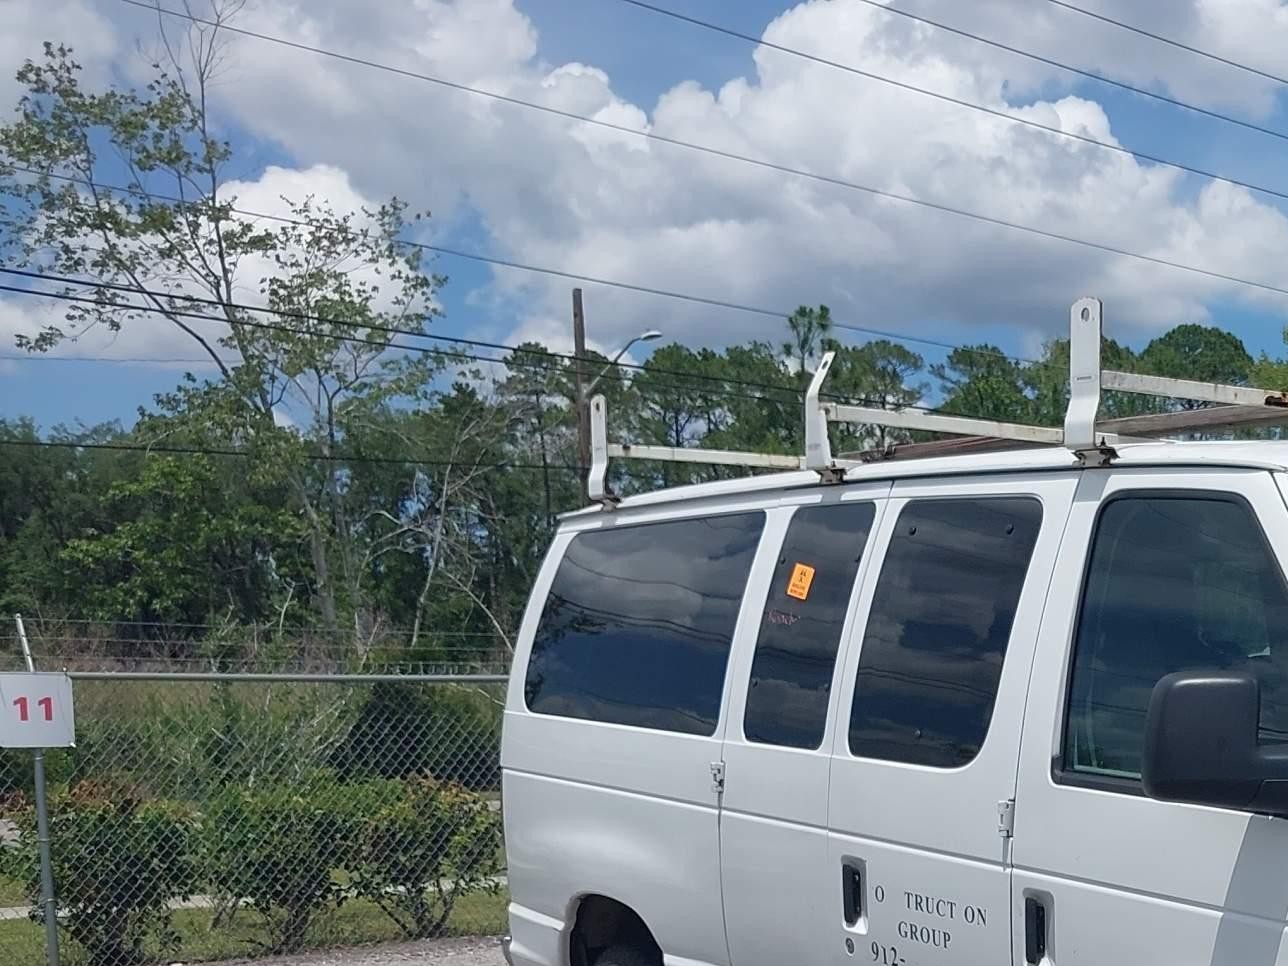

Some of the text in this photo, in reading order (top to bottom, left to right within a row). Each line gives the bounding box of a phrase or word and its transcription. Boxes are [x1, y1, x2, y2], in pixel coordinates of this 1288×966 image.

[13, 697, 53, 721] 11
[874, 885, 987, 926] O TRUCT ON
[898, 920, 951, 949] GROUP
